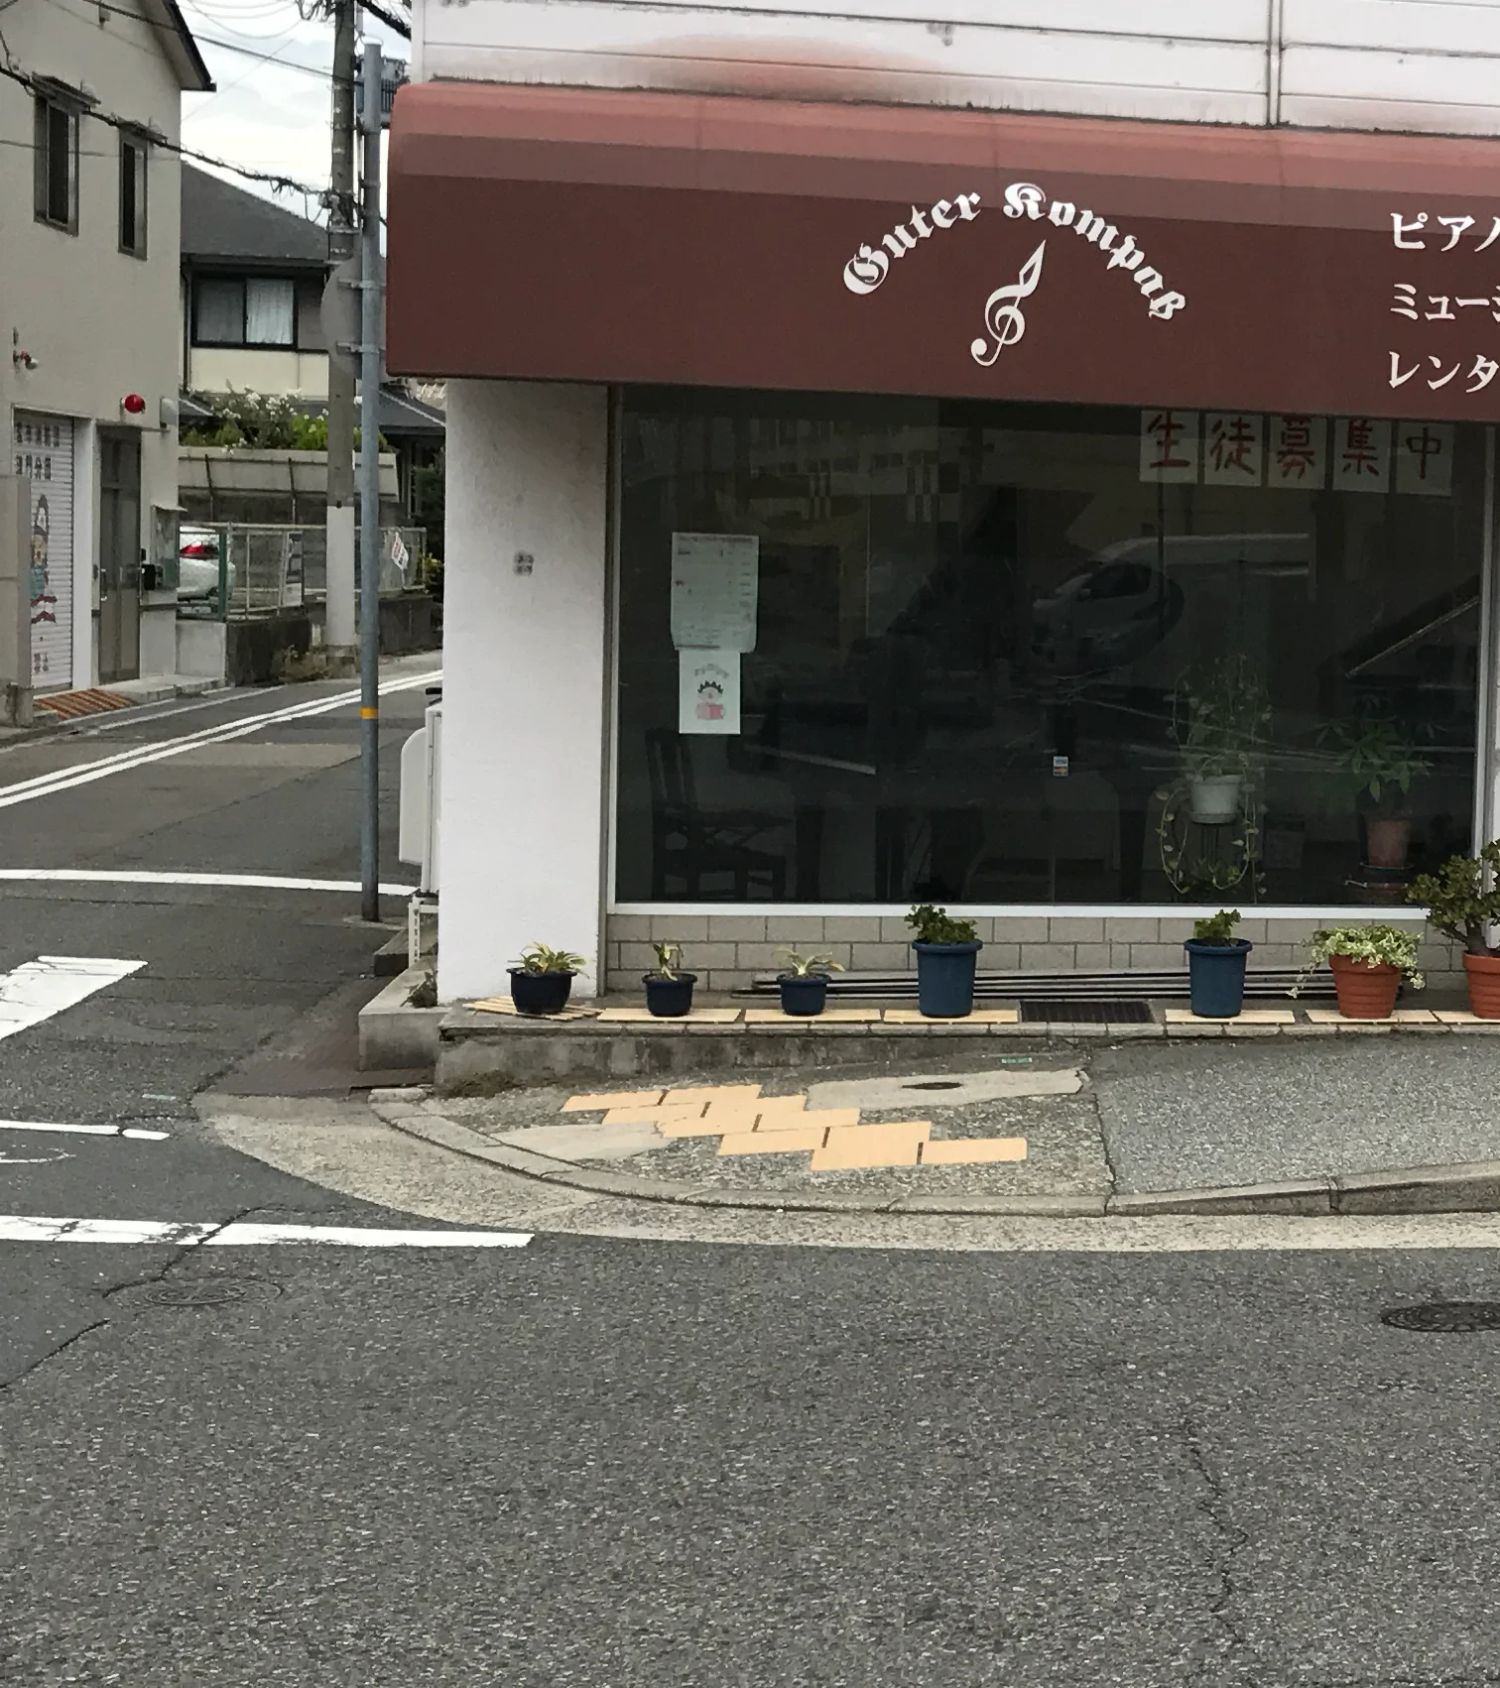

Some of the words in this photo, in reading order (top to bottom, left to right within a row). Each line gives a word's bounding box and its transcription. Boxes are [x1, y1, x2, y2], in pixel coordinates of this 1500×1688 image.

[843, 191, 981, 295] Guter
[1147, 411, 1442, 480] 生徒募集中
